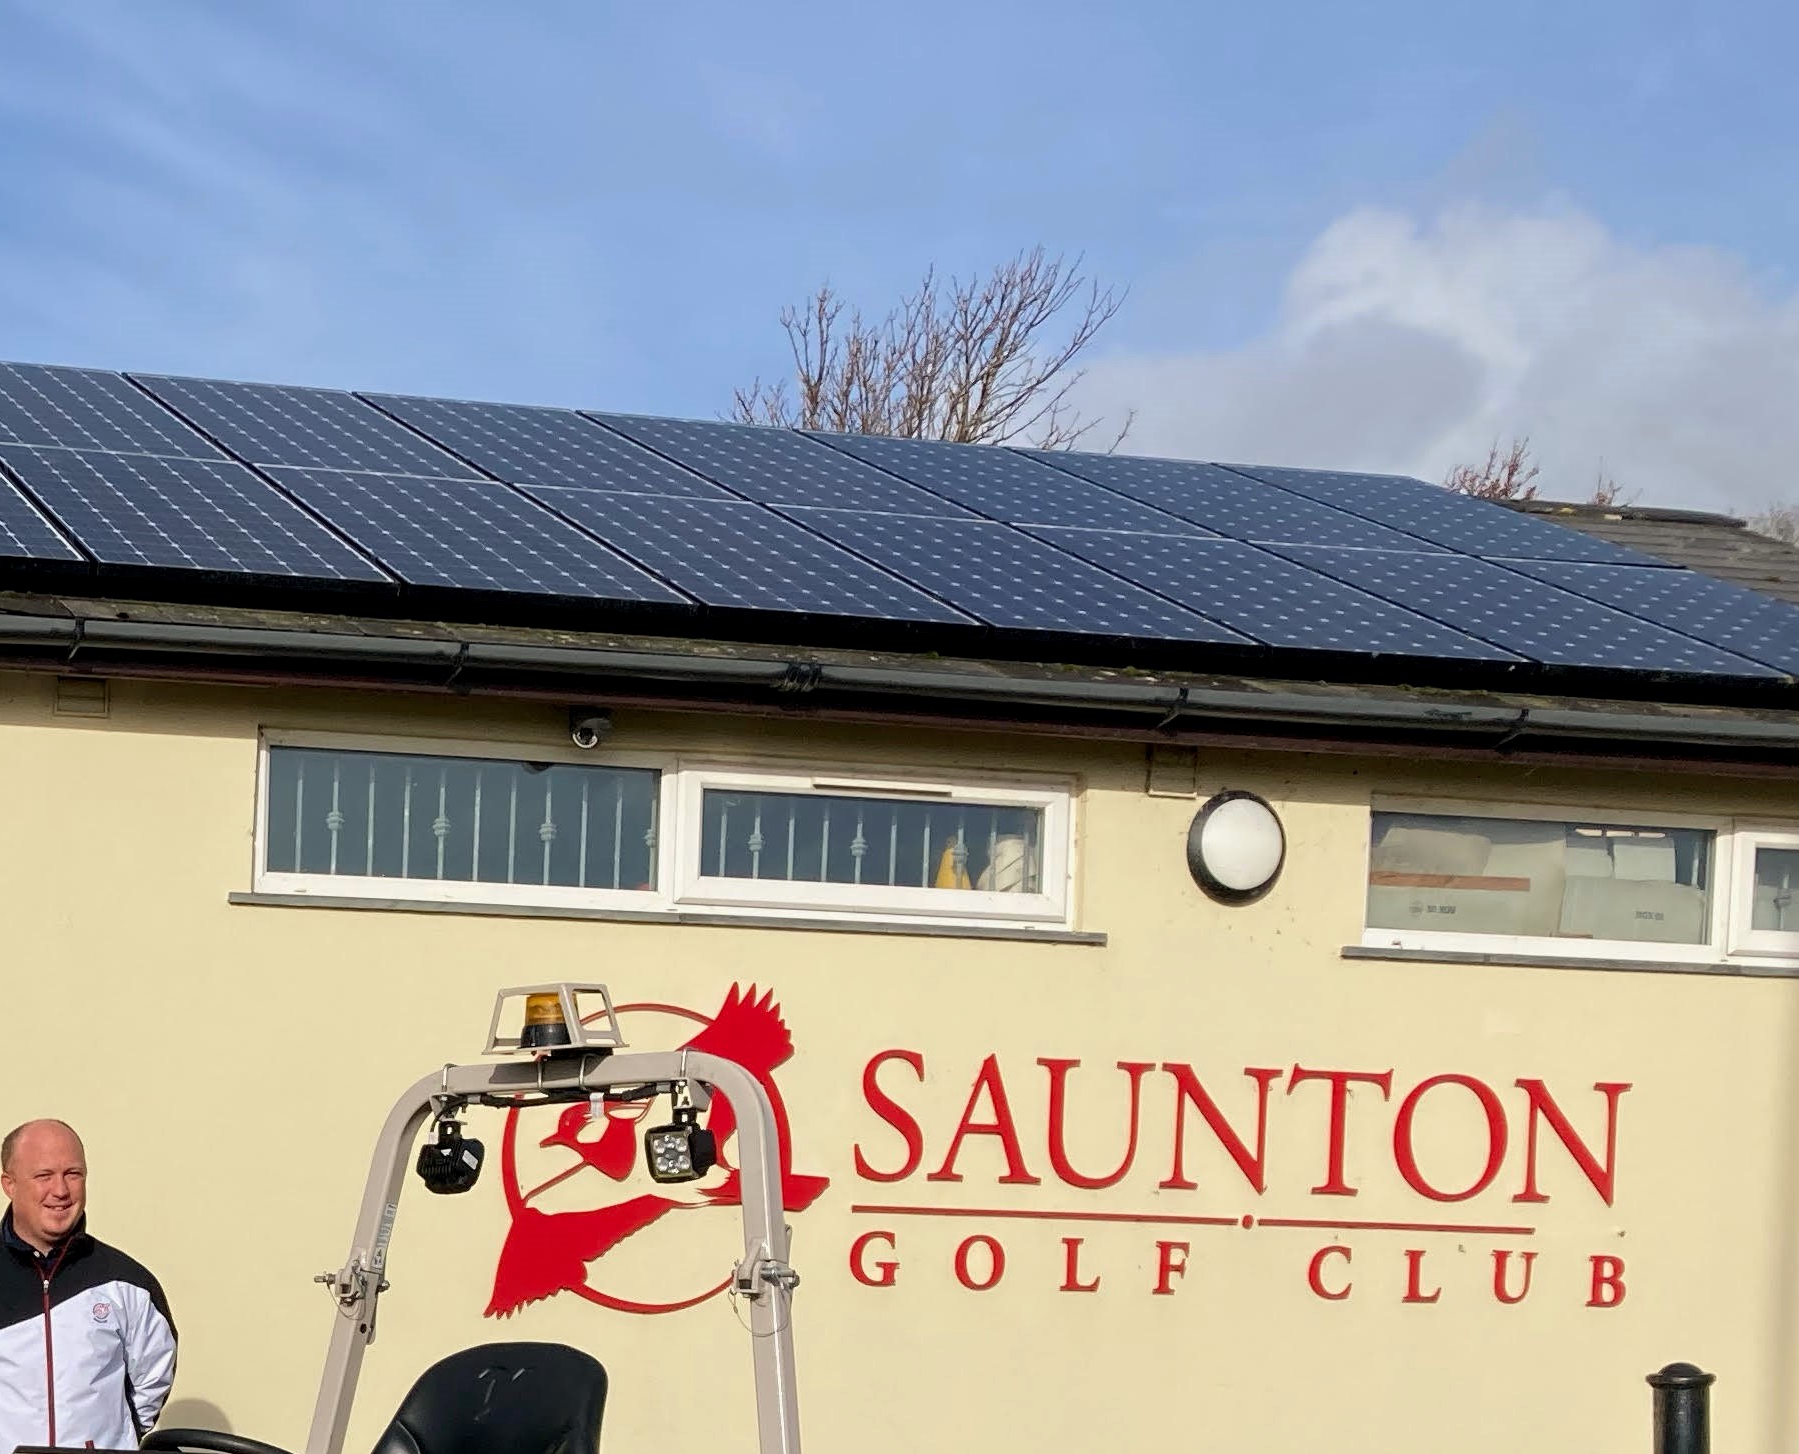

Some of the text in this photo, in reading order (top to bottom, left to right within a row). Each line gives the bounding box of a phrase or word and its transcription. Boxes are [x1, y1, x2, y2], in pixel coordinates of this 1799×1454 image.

[854, 1050, 1630, 1206] SAUNTON
[850, 1233, 1625, 1307] GOLF CLUB
